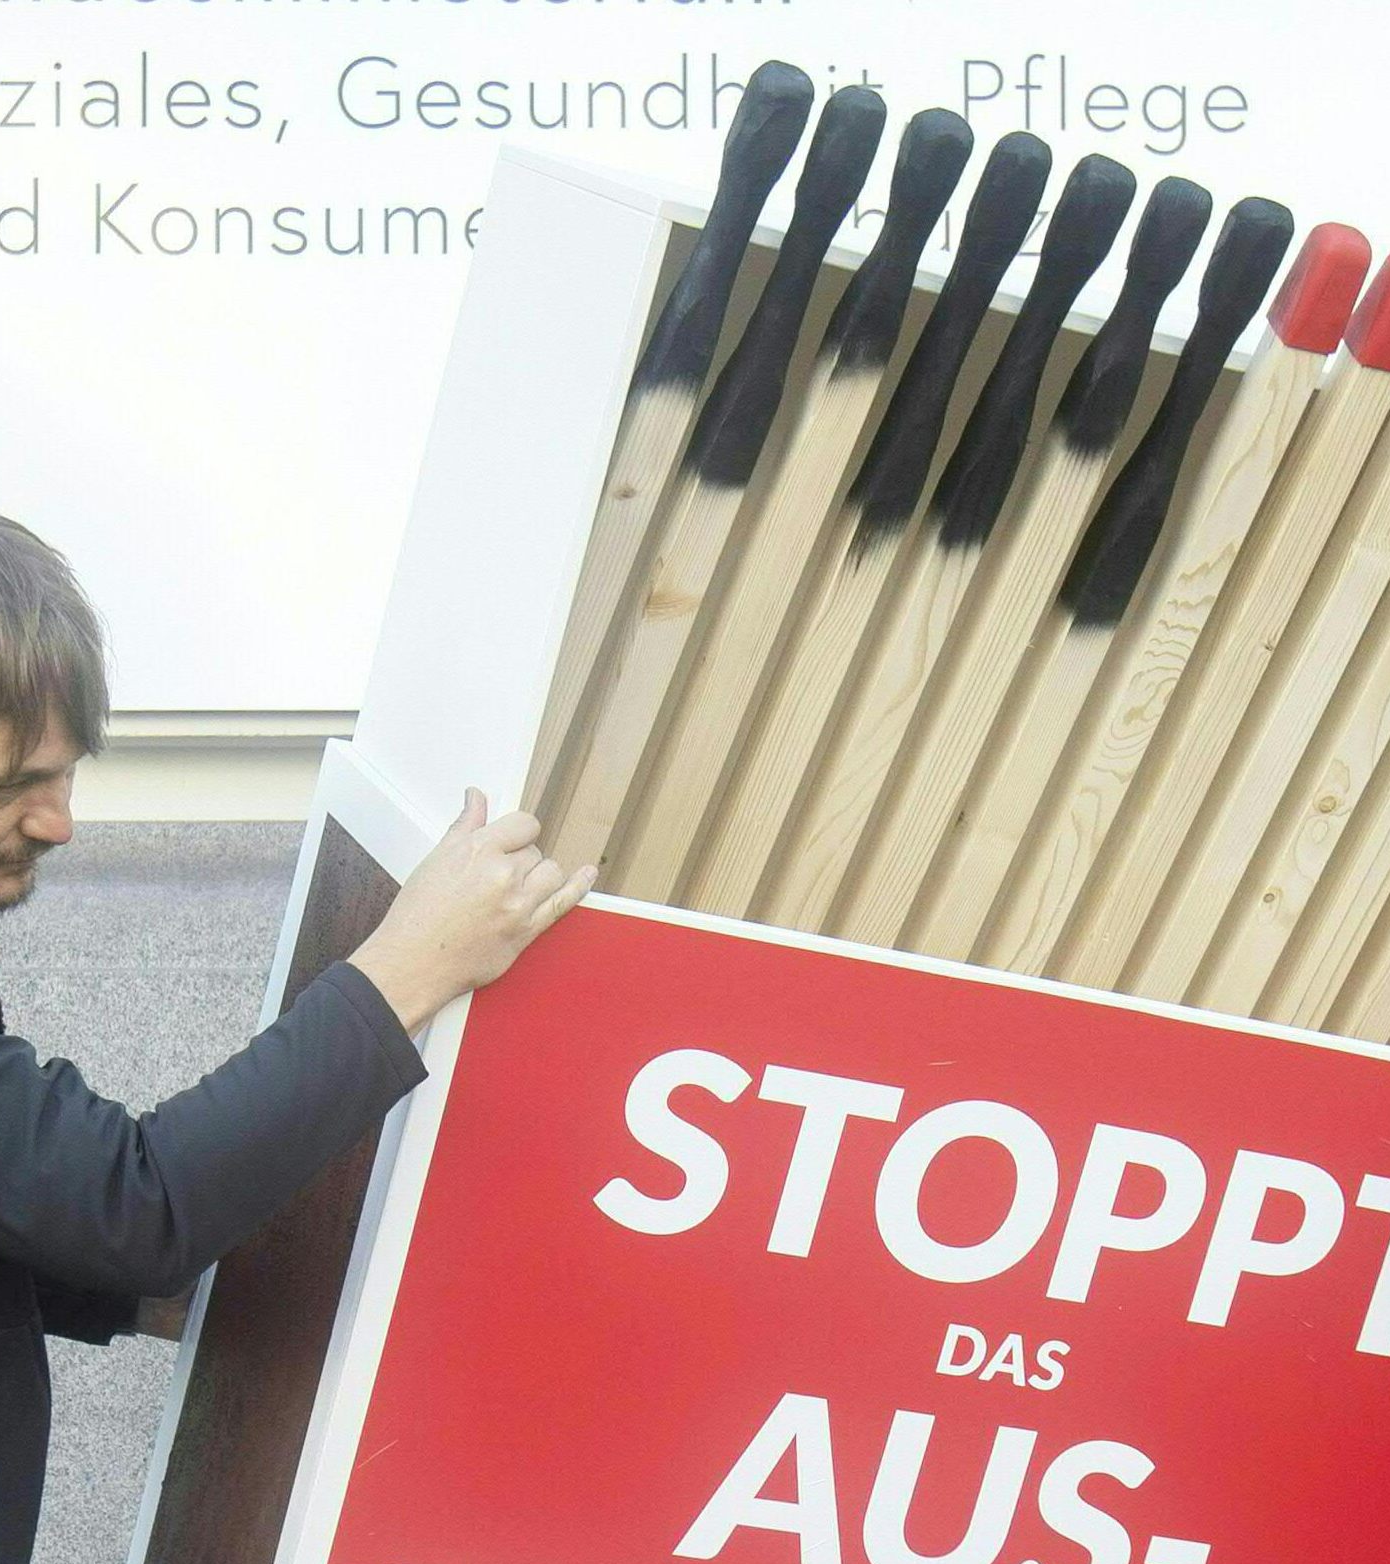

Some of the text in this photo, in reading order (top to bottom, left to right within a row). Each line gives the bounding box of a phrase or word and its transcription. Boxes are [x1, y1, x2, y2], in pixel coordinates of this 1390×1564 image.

[336, 52, 883, 131] Gesundh
[964, 54, 1250, 156] Pflege
[936, 1324, 1069, 1392] DAS
